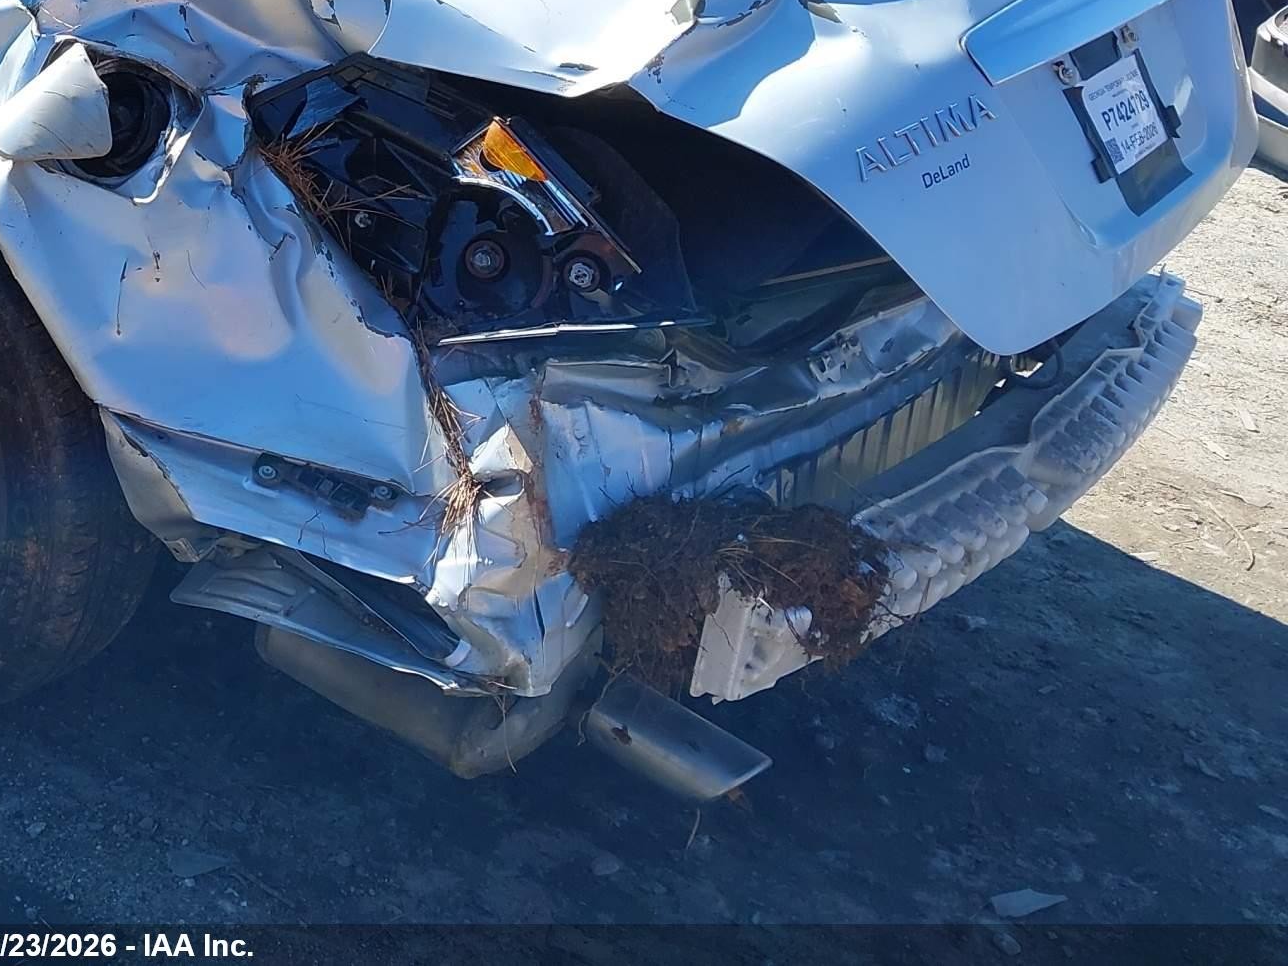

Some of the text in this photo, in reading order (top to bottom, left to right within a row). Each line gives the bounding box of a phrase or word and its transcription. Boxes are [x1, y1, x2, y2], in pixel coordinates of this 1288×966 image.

[1100, 90, 1151, 131] P7424729
[855, 94, 997, 183] ALTIMA
[921, 153, 971, 188] DeLand
